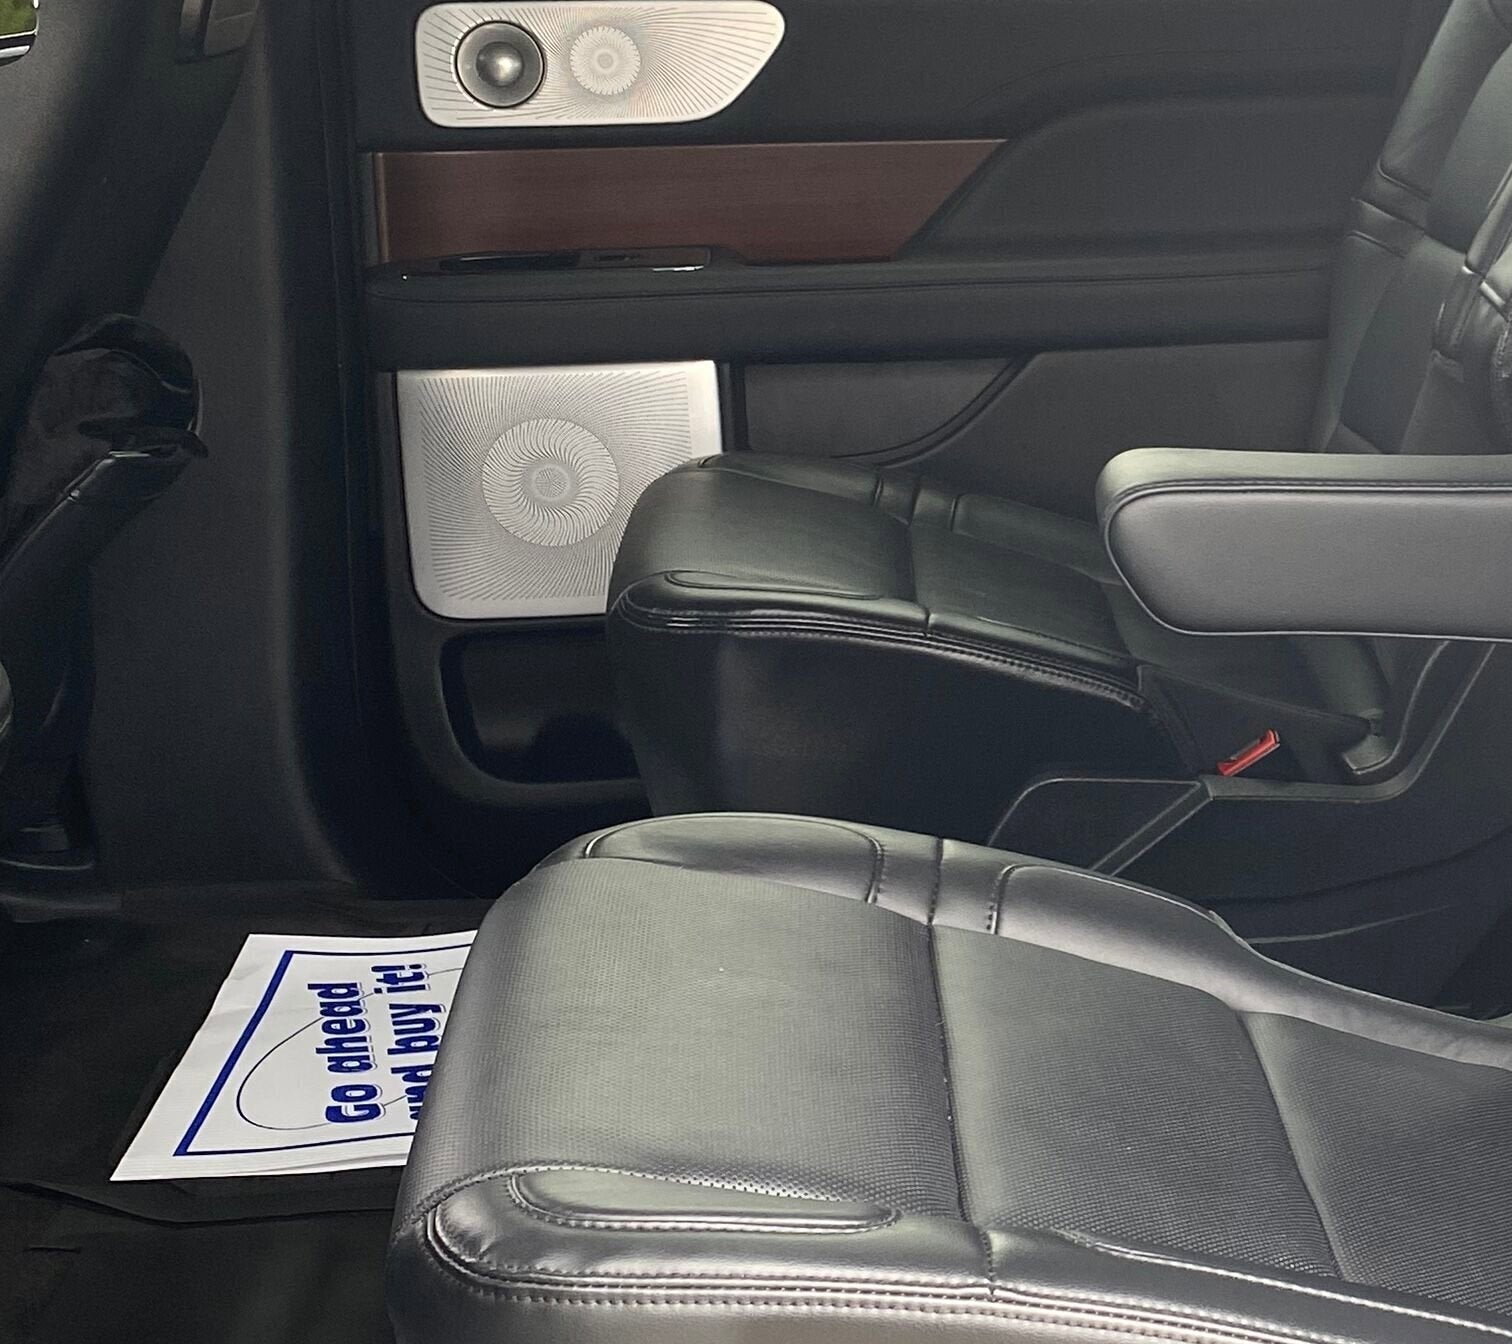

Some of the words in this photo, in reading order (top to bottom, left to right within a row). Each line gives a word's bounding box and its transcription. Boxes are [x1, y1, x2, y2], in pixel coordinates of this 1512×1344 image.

[371, 963, 430, 994] it!
[307, 982, 377, 1074] ahead
[387, 1003, 446, 1055] buy
[324, 1084, 385, 1123] Go
